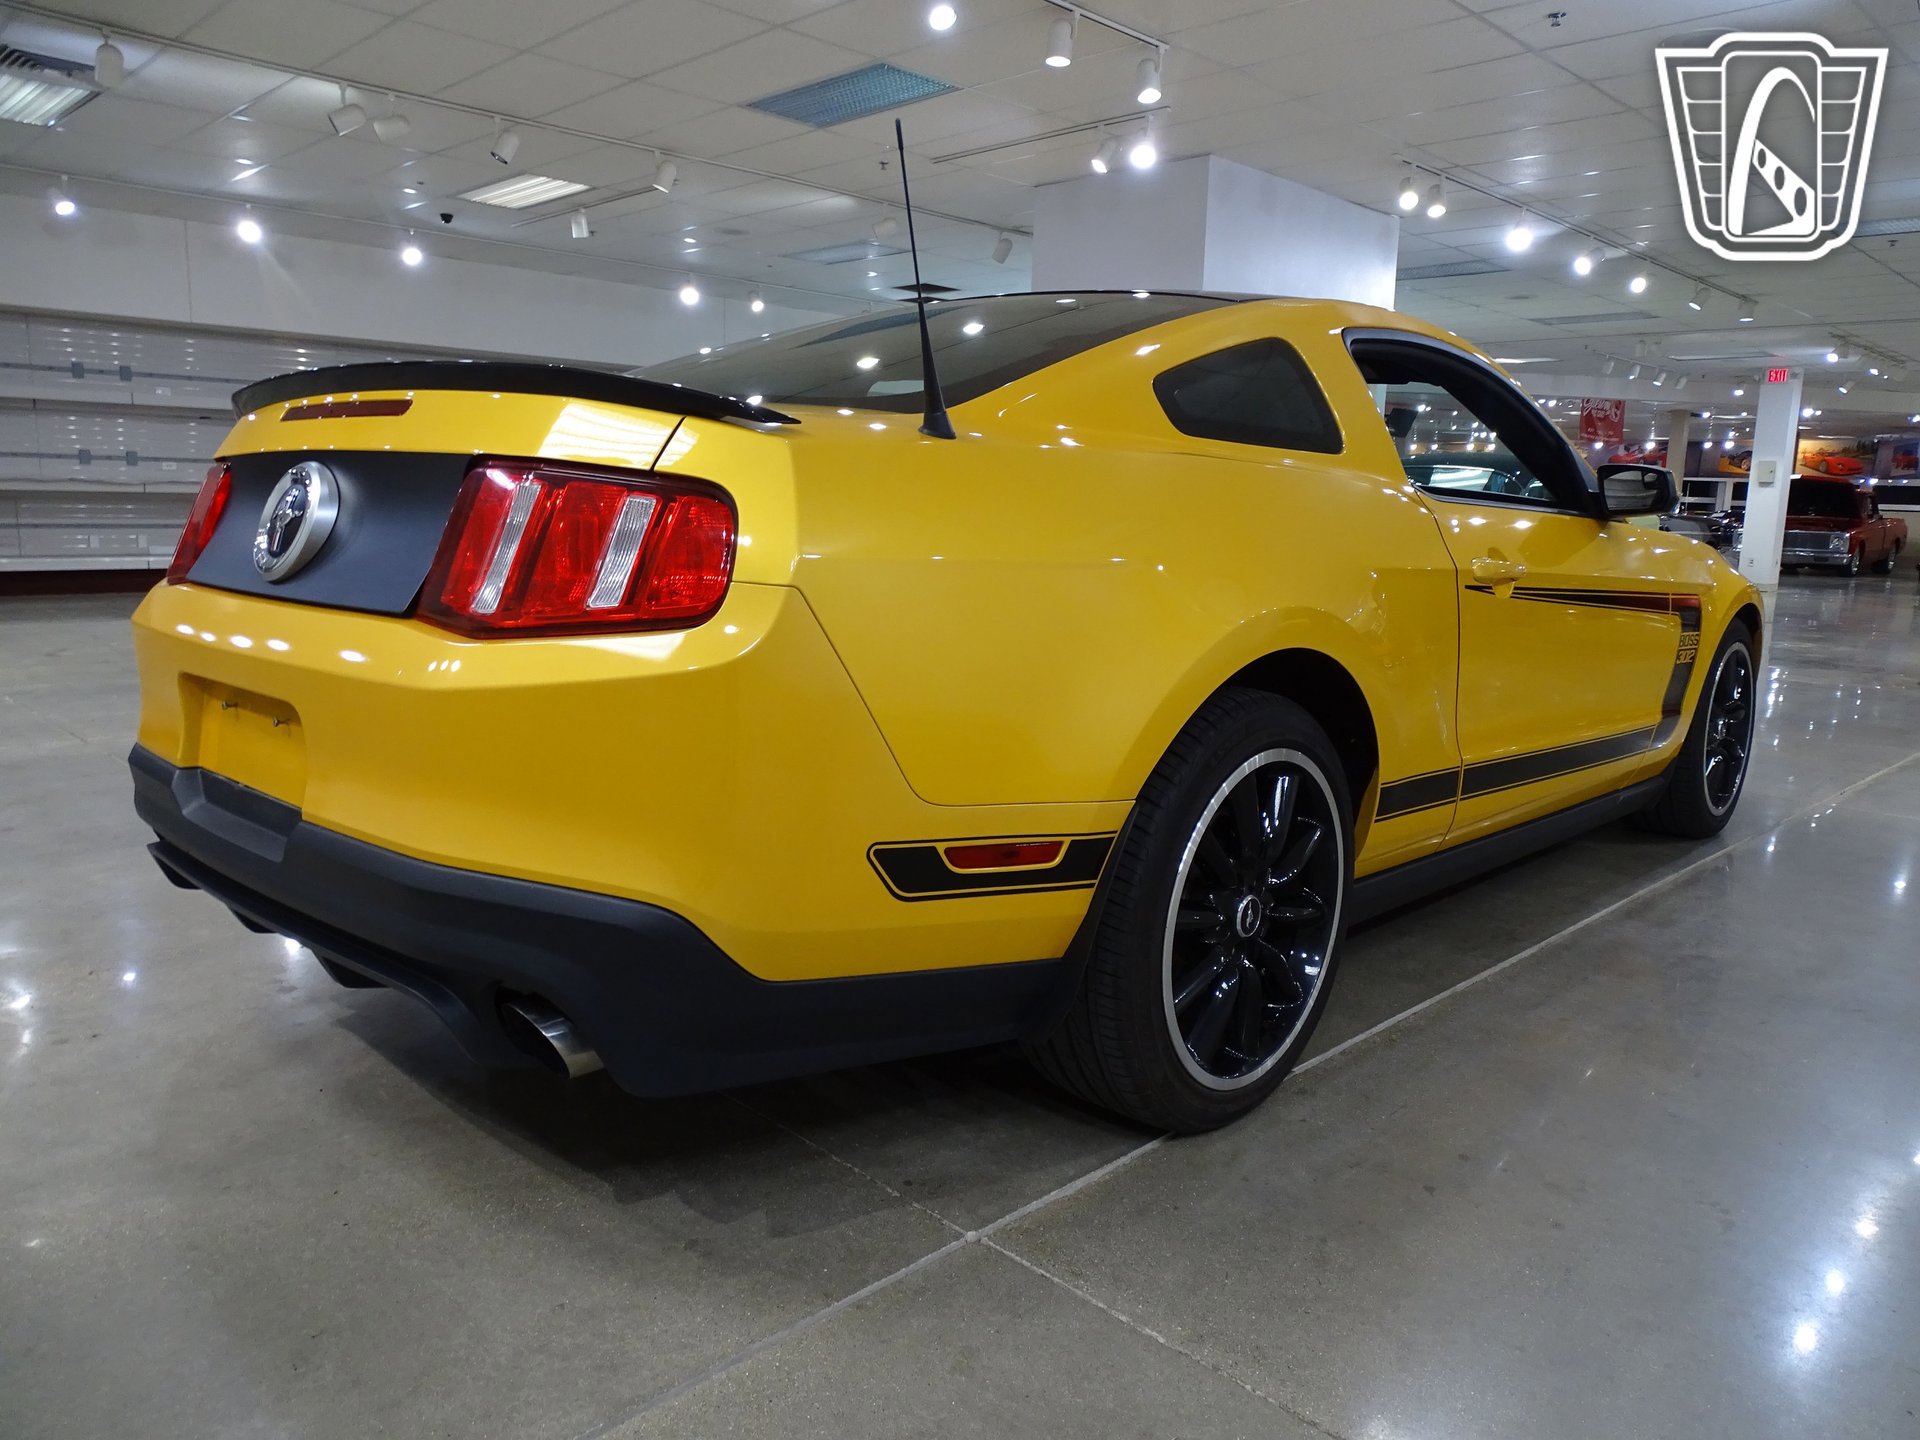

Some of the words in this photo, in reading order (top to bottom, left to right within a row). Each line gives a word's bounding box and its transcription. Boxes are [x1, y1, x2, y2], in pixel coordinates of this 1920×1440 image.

[1768, 369, 1788, 383] EXIT
[1679, 634, 1699, 648] BOSS
[1676, 649, 1695, 664] 302
